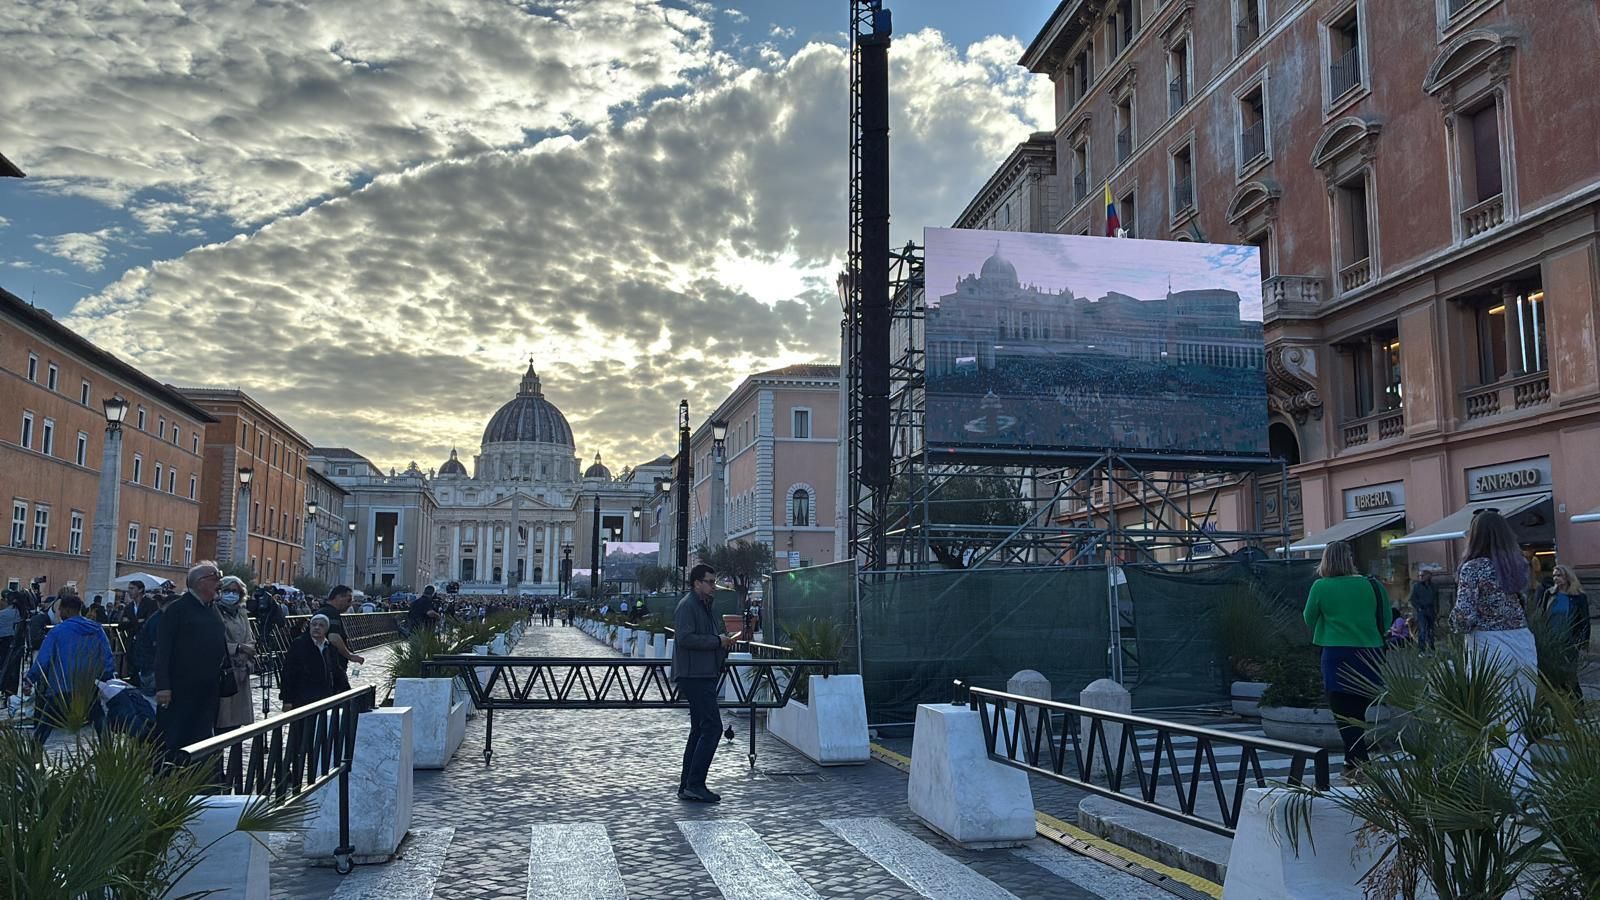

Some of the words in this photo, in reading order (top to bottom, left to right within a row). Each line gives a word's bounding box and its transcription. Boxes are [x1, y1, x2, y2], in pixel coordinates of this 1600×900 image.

[1476, 476, 1497, 491] SAN
[1499, 469, 1537, 488] PAOLO
[1354, 490, 1390, 508] LIBRERIA
